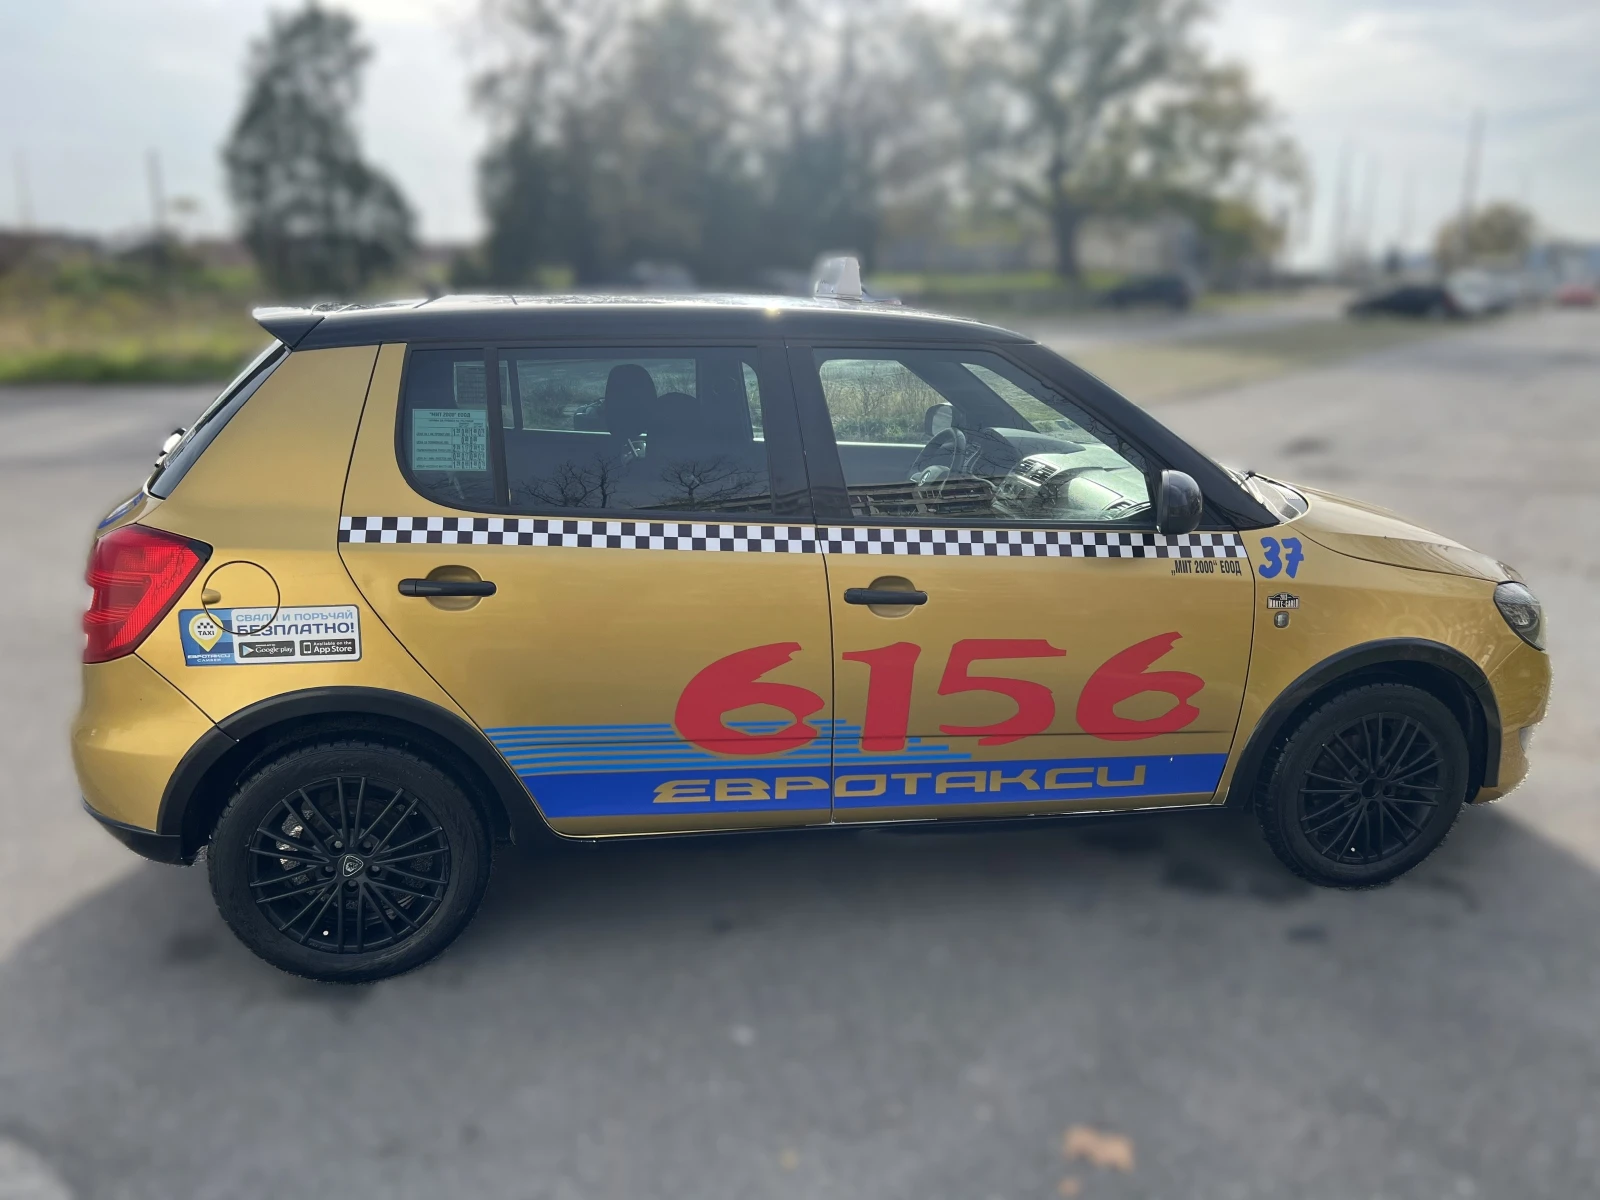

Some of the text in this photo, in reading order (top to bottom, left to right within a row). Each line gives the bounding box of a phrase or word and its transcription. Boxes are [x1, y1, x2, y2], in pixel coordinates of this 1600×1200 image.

[1258, 536, 1305, 579] 37
[1219, 560, 1243, 576] ЕООД
[235, 609, 354, 622] СВАЛИ И ПОРЪЧАЙ
[236, 622, 355, 637] БЕЗПЛАТНО!
[255, 646, 294, 655] Google play
[313, 645, 353, 654] App Store
[674, 631, 1206, 755] 6156
